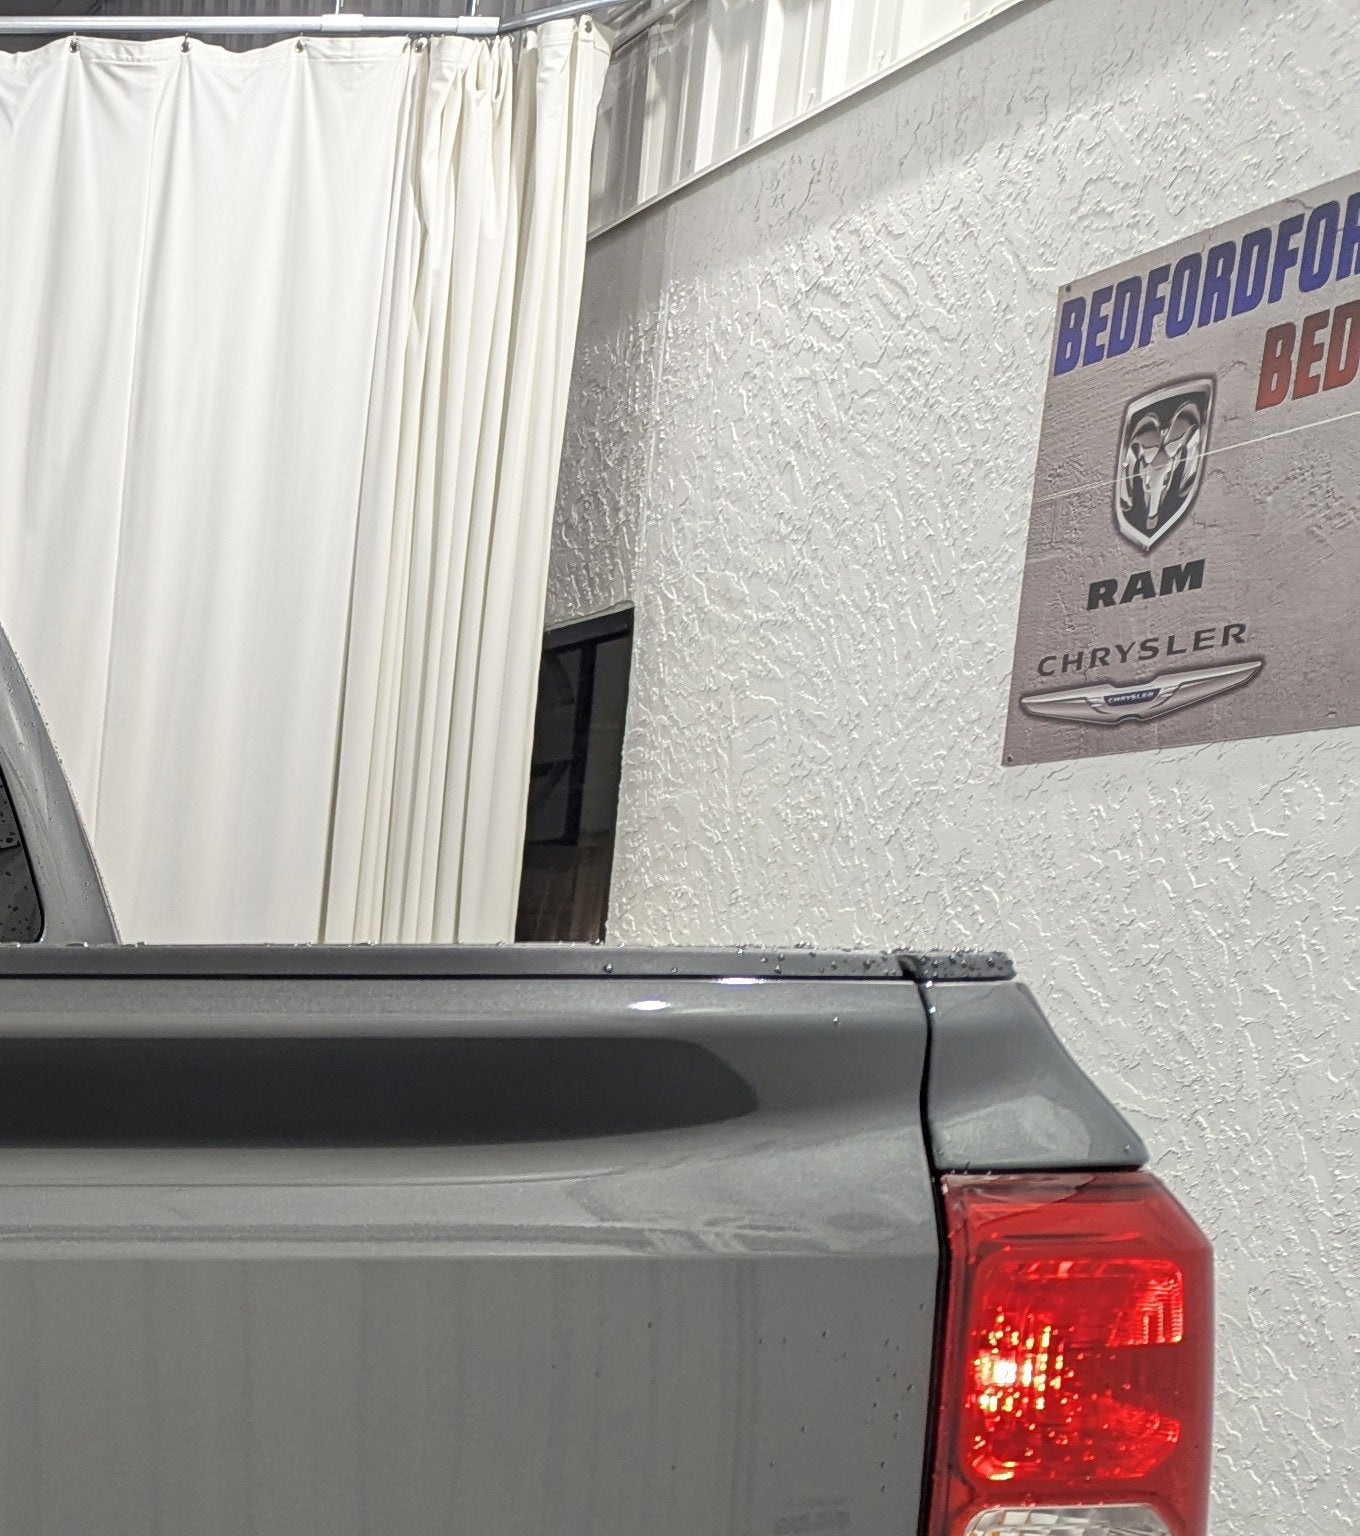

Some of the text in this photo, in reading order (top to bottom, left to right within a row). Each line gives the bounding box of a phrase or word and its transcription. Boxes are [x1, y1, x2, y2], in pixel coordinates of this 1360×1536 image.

[1255, 300, 1360, 411] BED
[1087, 559, 1206, 611] RAM
[1037, 623, 1247, 677] CHRYSLER
[1108, 691, 1155, 703] CHRYSLER
